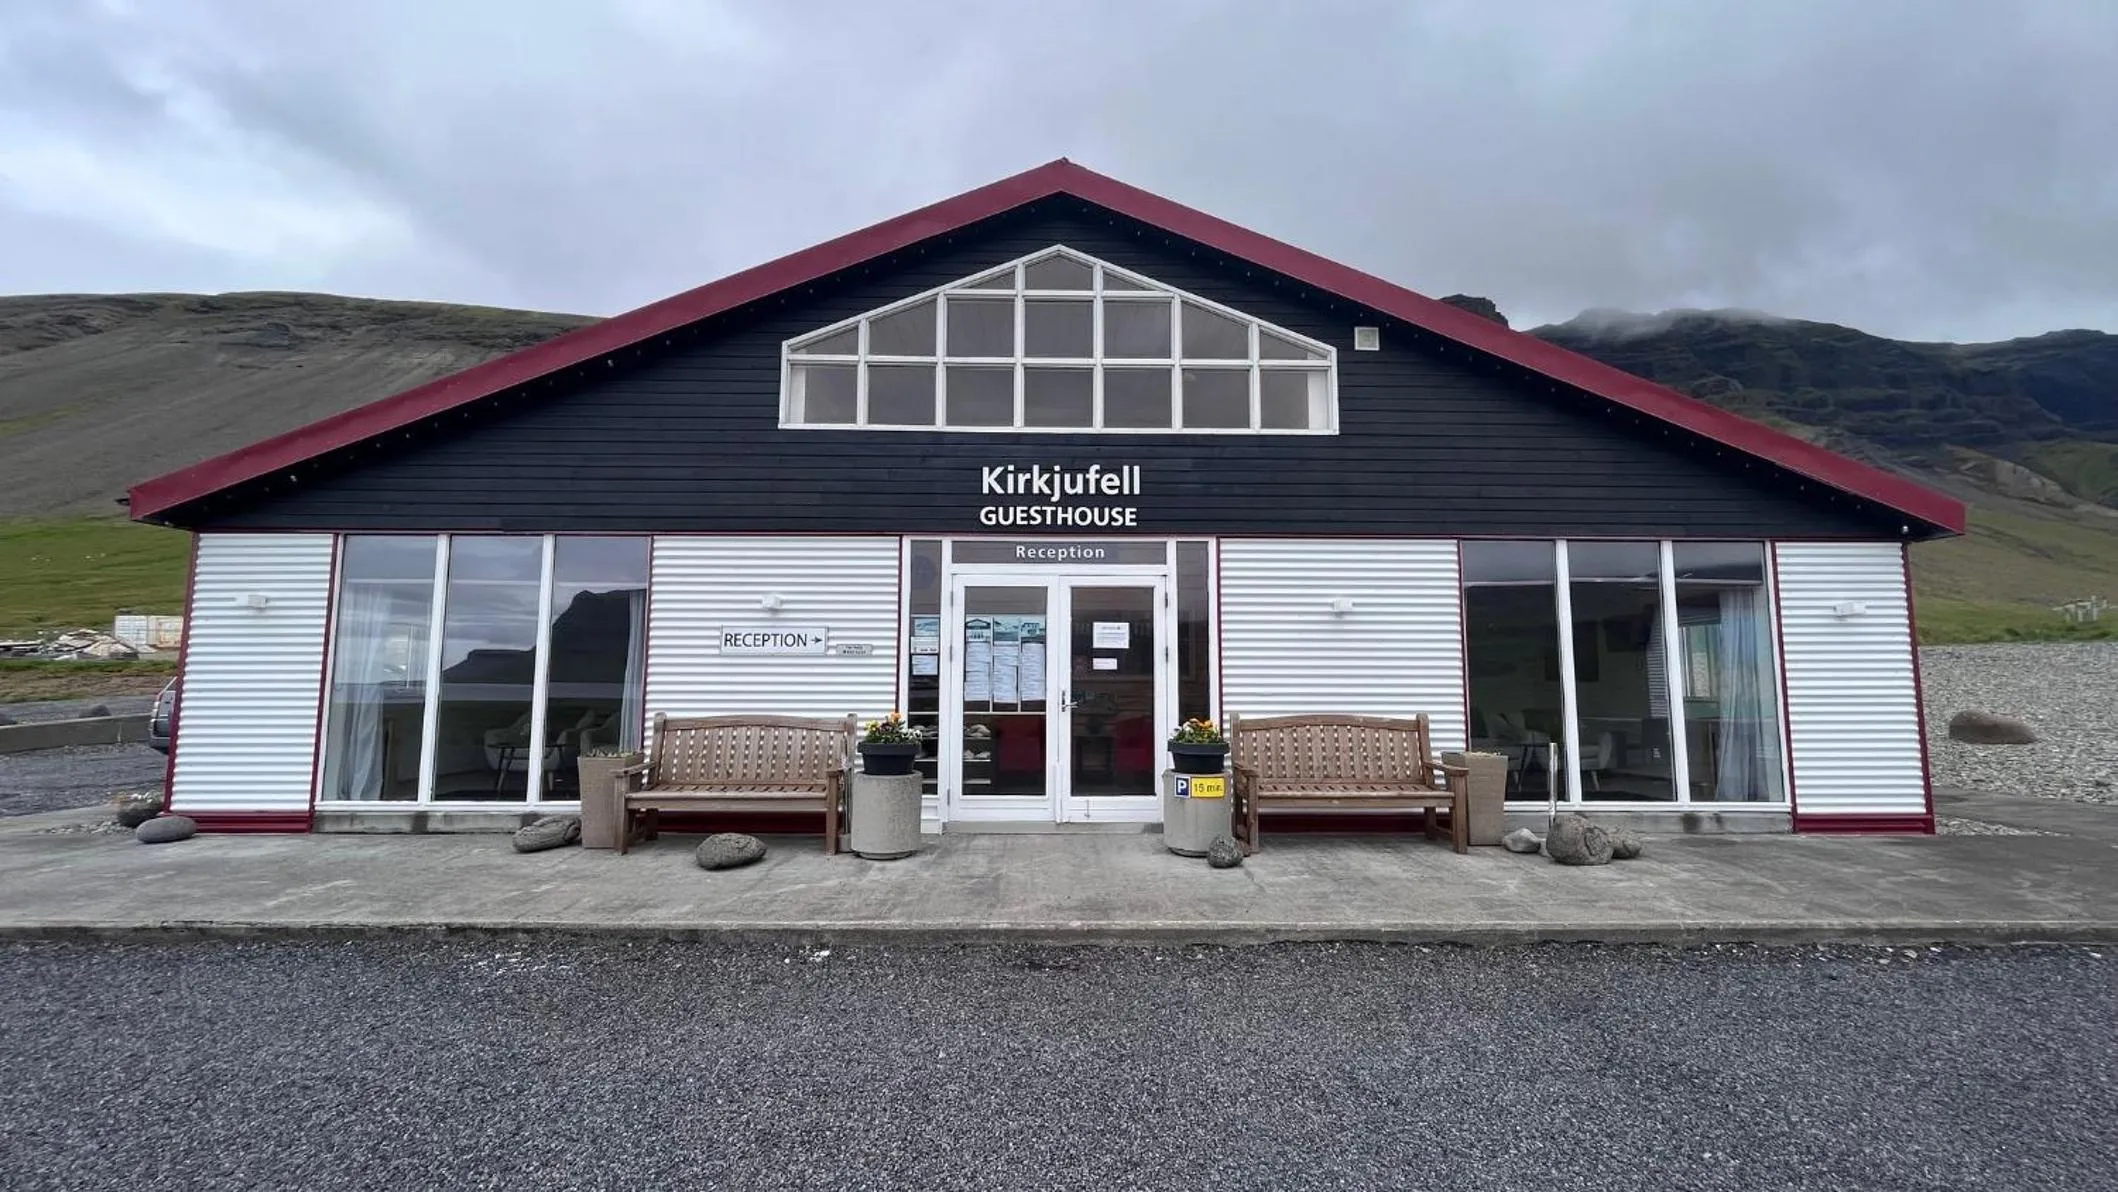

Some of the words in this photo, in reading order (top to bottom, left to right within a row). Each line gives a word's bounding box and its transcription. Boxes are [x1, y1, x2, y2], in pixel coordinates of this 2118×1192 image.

[981, 464, 1141, 502] Kirkjufell
[979, 506, 1138, 527] GUESTHOUSE
[1015, 545, 1106, 561] Reception
[723, 633, 808, 648] RECEPTION
[1194, 783, 1204, 792] 15
